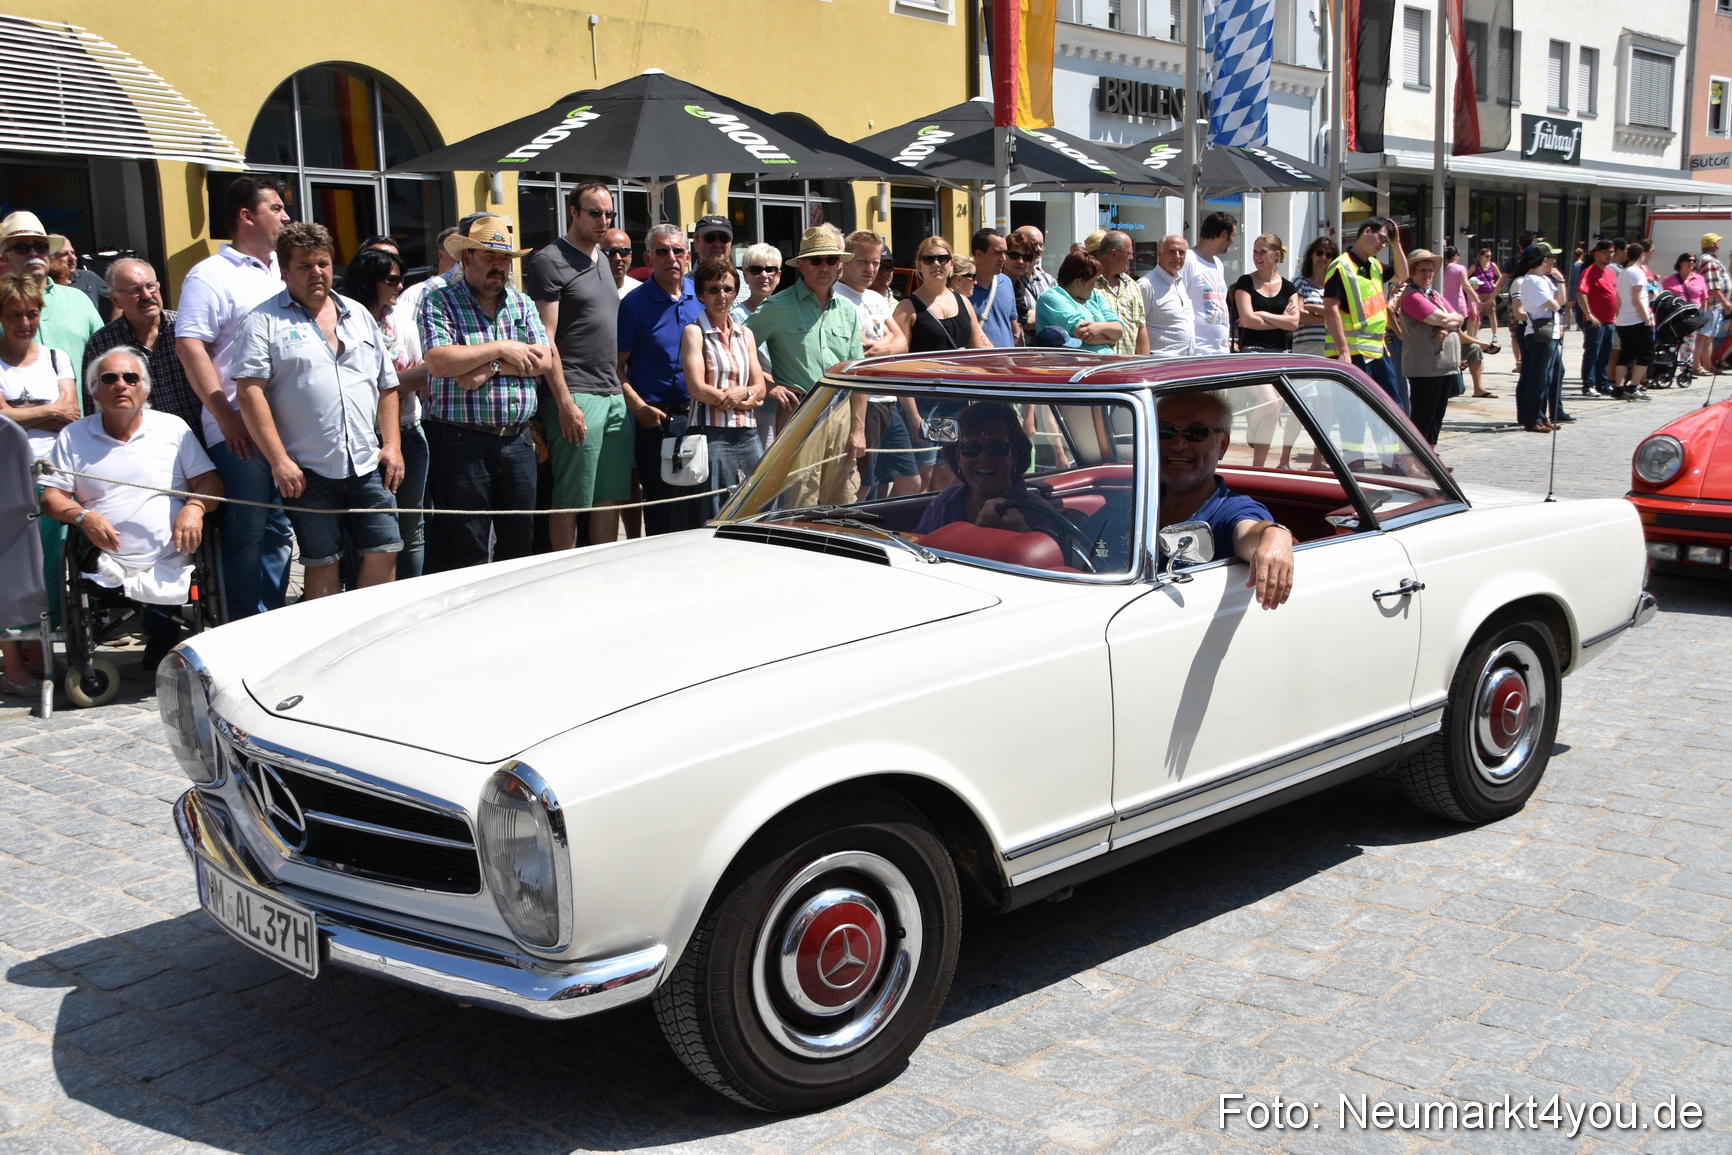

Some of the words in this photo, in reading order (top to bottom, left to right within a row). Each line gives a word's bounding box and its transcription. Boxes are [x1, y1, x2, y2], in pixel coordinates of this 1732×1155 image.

[505, 105, 601, 158] now
[683, 105, 791, 159] now
[1524, 120, 1581, 160] frühauf
[1142, 144, 1183, 170] ow
[1240, 147, 1312, 179] now
[956, 203, 968, 218] 24
